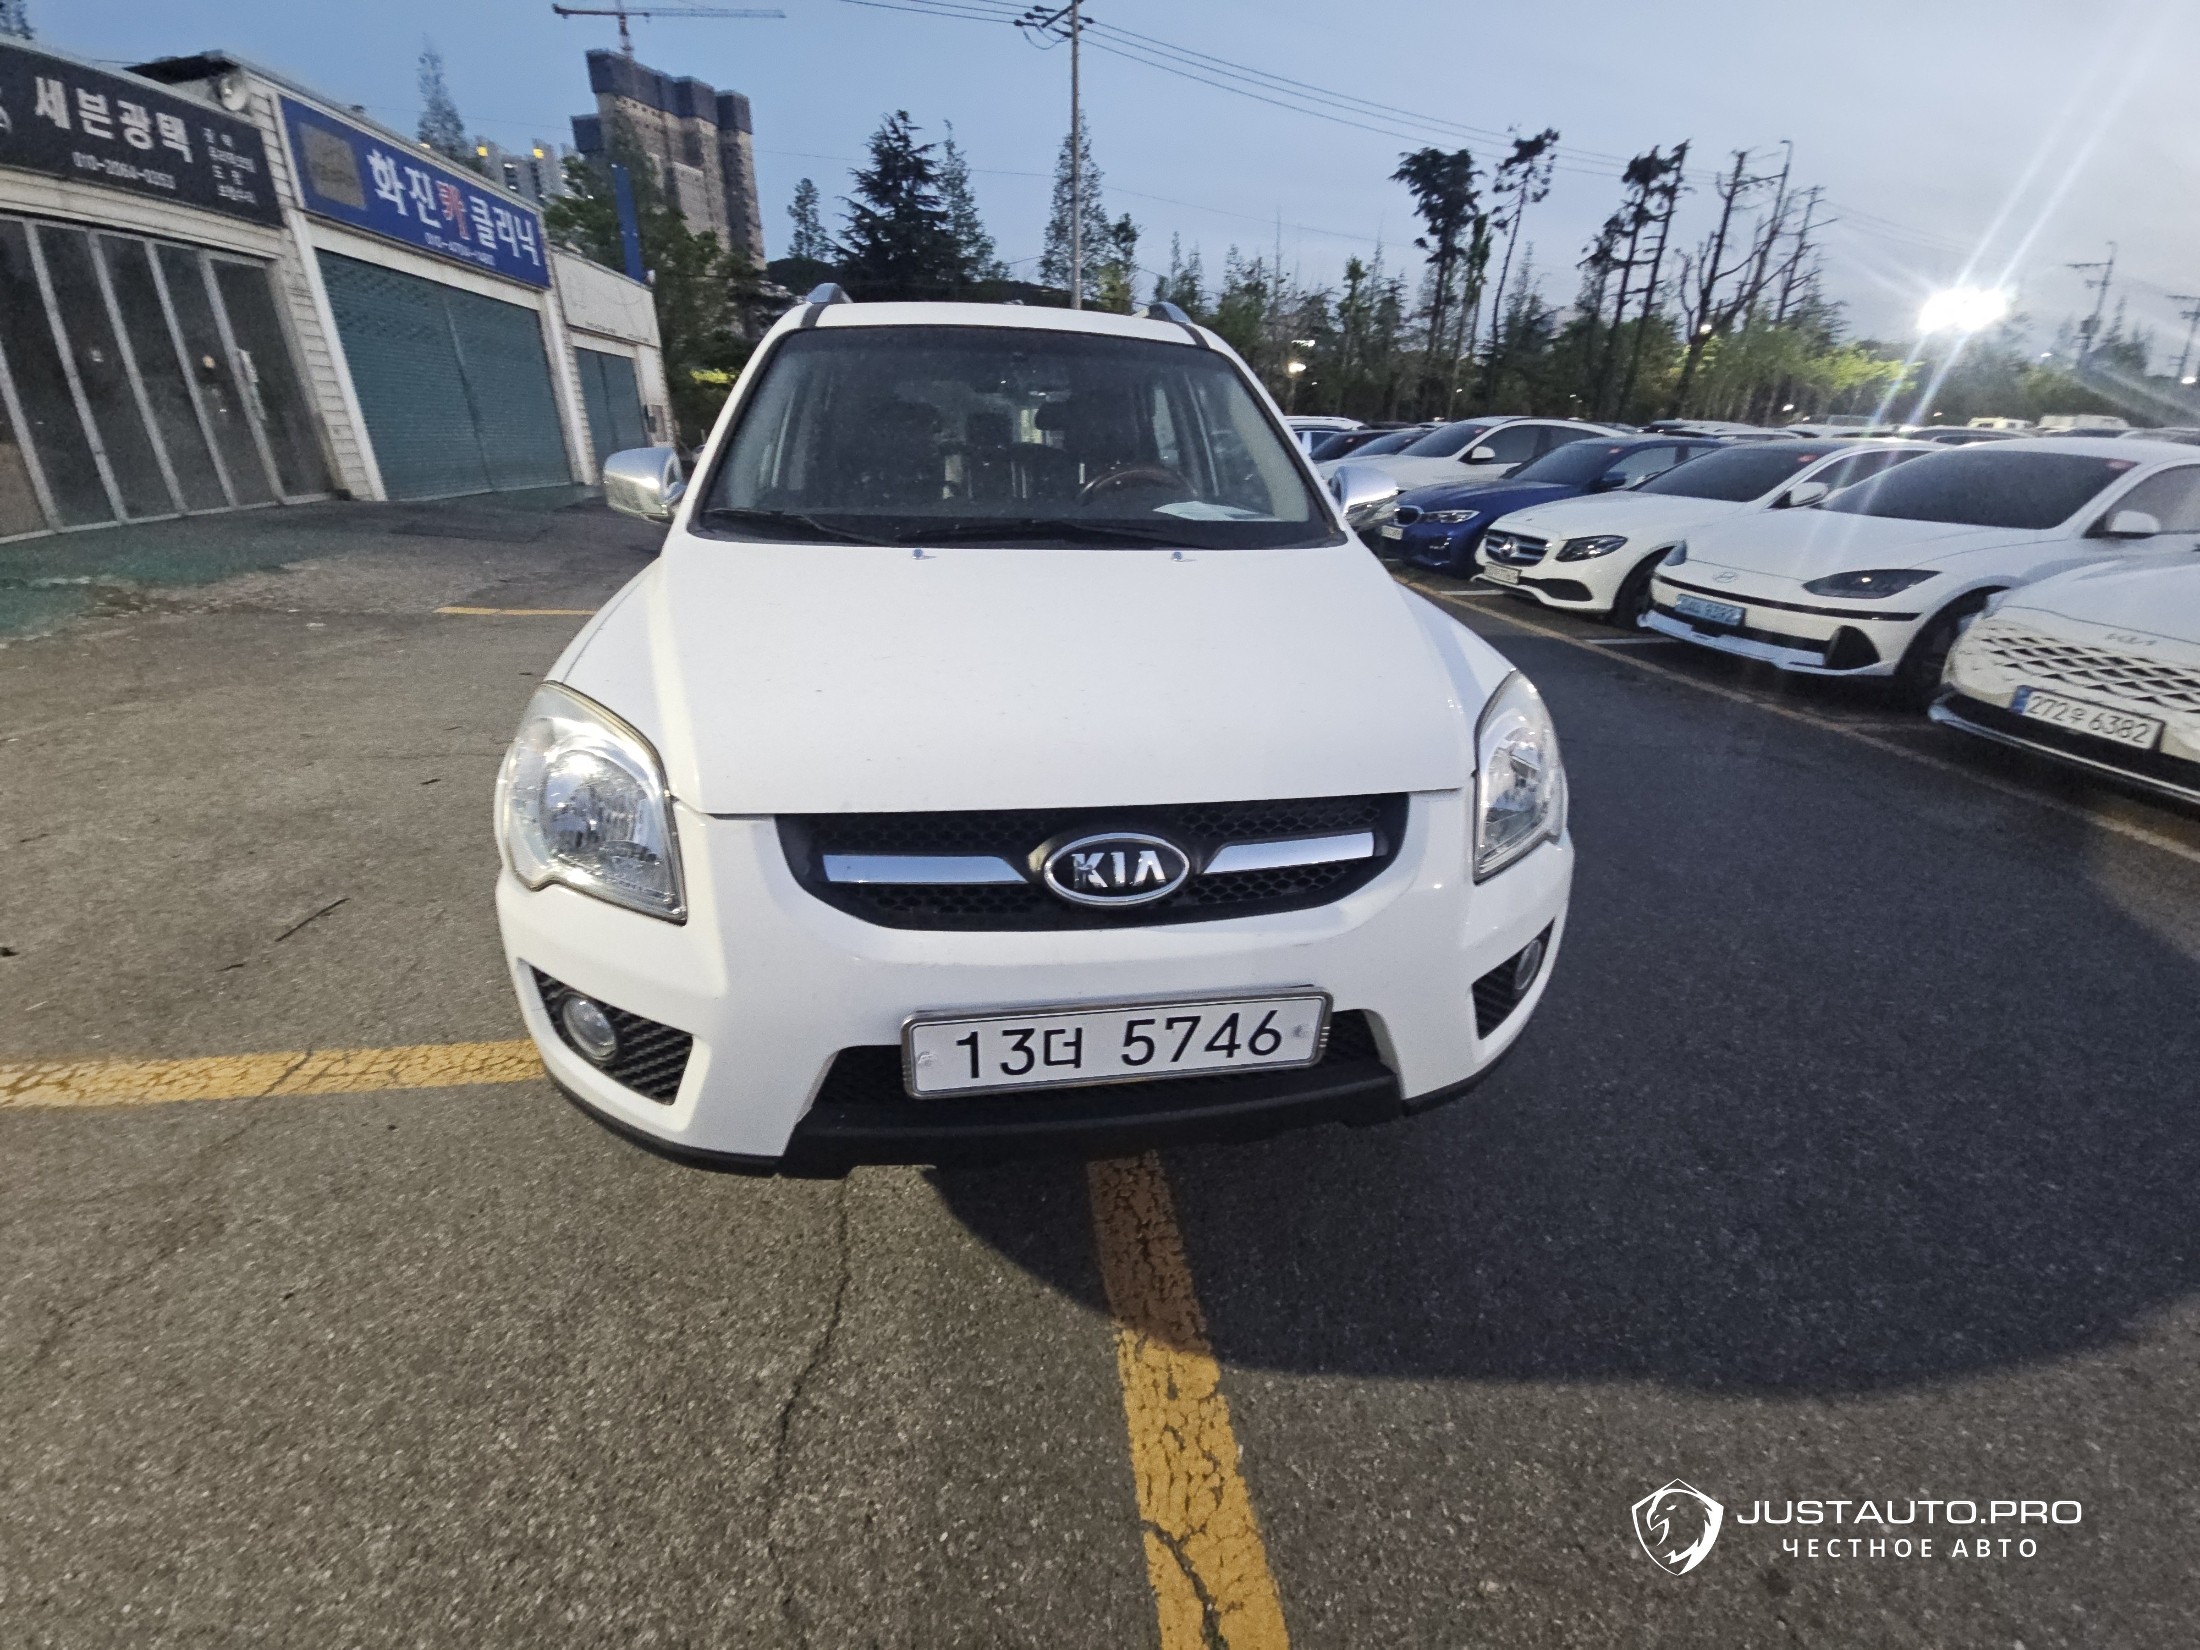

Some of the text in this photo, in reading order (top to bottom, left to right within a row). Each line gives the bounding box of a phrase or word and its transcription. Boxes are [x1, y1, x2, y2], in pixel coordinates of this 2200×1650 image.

[35, 77, 193, 163] 세븐광택
[1072, 850, 1167, 889] KIA
[956, 1010, 1283, 1079] 13더 5746
